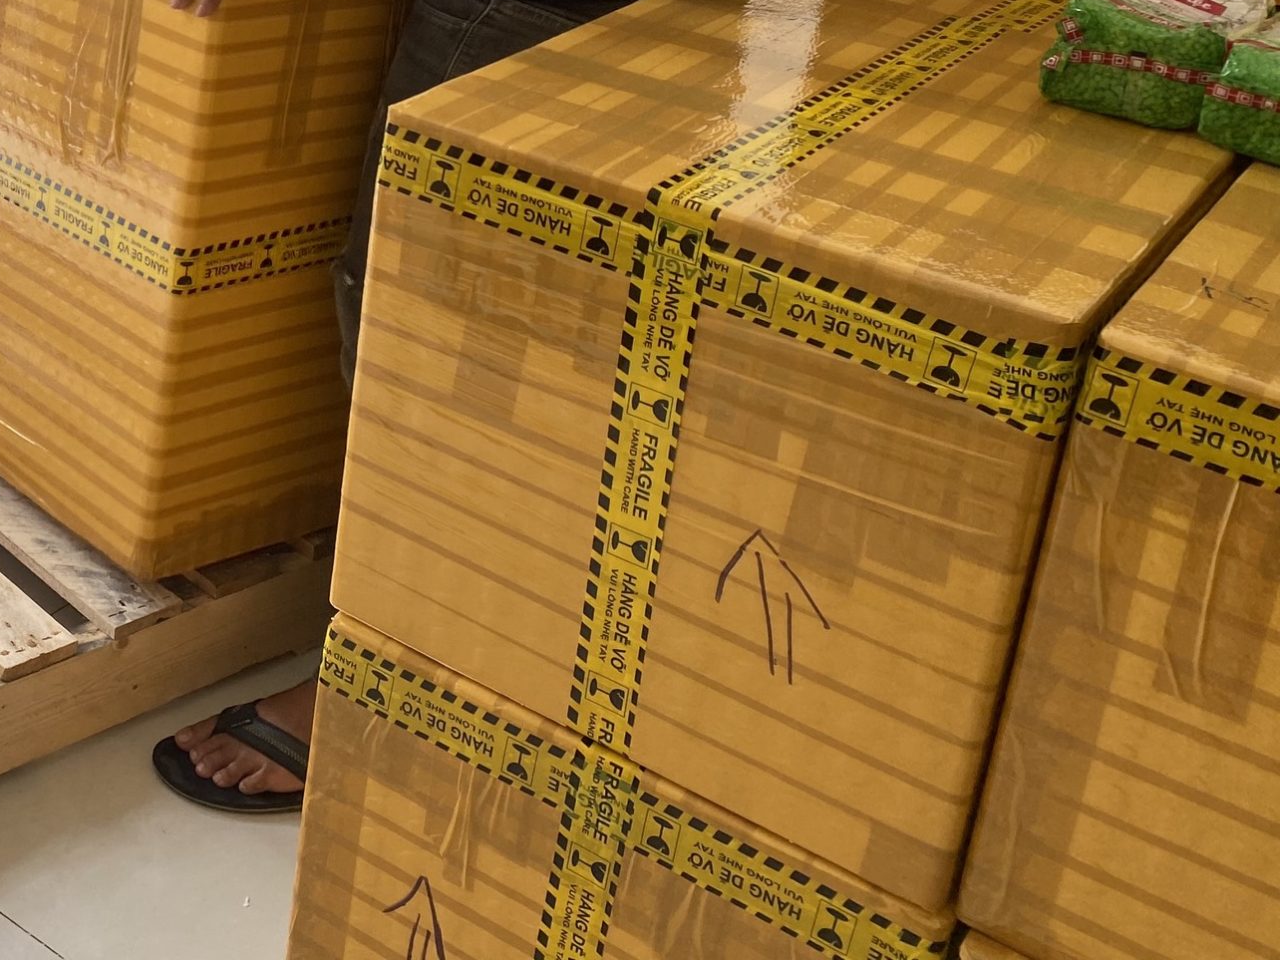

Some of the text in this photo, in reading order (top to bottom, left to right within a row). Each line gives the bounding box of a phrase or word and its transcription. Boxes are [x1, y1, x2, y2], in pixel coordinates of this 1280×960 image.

[818, 103, 863, 128] FRAGILE
[383, 155, 418, 181] FRA
[394, 148, 420, 165] HAND
[473, 176, 493, 191] TAY
[54, 204, 94, 235] FRAGILE
[466, 188, 573, 237] HÀNG DỄ VỠ
[557, 203, 573, 218] VUI
[143, 254, 169, 277] HÀNG
[204, 259, 253, 279] FRAGILE
[705, 258, 729, 273] HAN
[793, 289, 819, 306] TAY
[653, 270, 685, 382] HÀNG DỄ VỠ
[785, 301, 915, 363] HÀNG DỄ VỠ
[896, 326, 917, 343] VUI
[640, 351, 652, 373] TAY
[1145, 411, 1183, 436] VỠ
[1156, 397, 1277, 445] LÒNG NHẸ TAY
[1189, 424, 1226, 450] DỄ
[620, 427, 640, 515] HAND WITH CARE
[632, 432, 659, 521] FRAGILE
[610, 568, 620, 588] VUI
[609, 571, 638, 674] HÀNG DỄ VỠ
[334, 653, 357, 670] HAND
[598, 647, 609, 664] TAY
[324, 656, 355, 686] FRA
[404, 691, 424, 705] TAY
[398, 700, 494, 759] HÀNG DỄ VỠ
[477, 727, 495, 742] VUI
[598, 716, 616, 745] FR
[550, 765, 570, 781] ARE
[593, 761, 624, 845] FRAGILE
[692, 841, 715, 857] TAY
[567, 884, 577, 900] VUI
[686, 851, 803, 922] HÀNG DỄ VỠ
[785, 887, 805, 904] VUI
[574, 889, 596, 934] HÀNG
